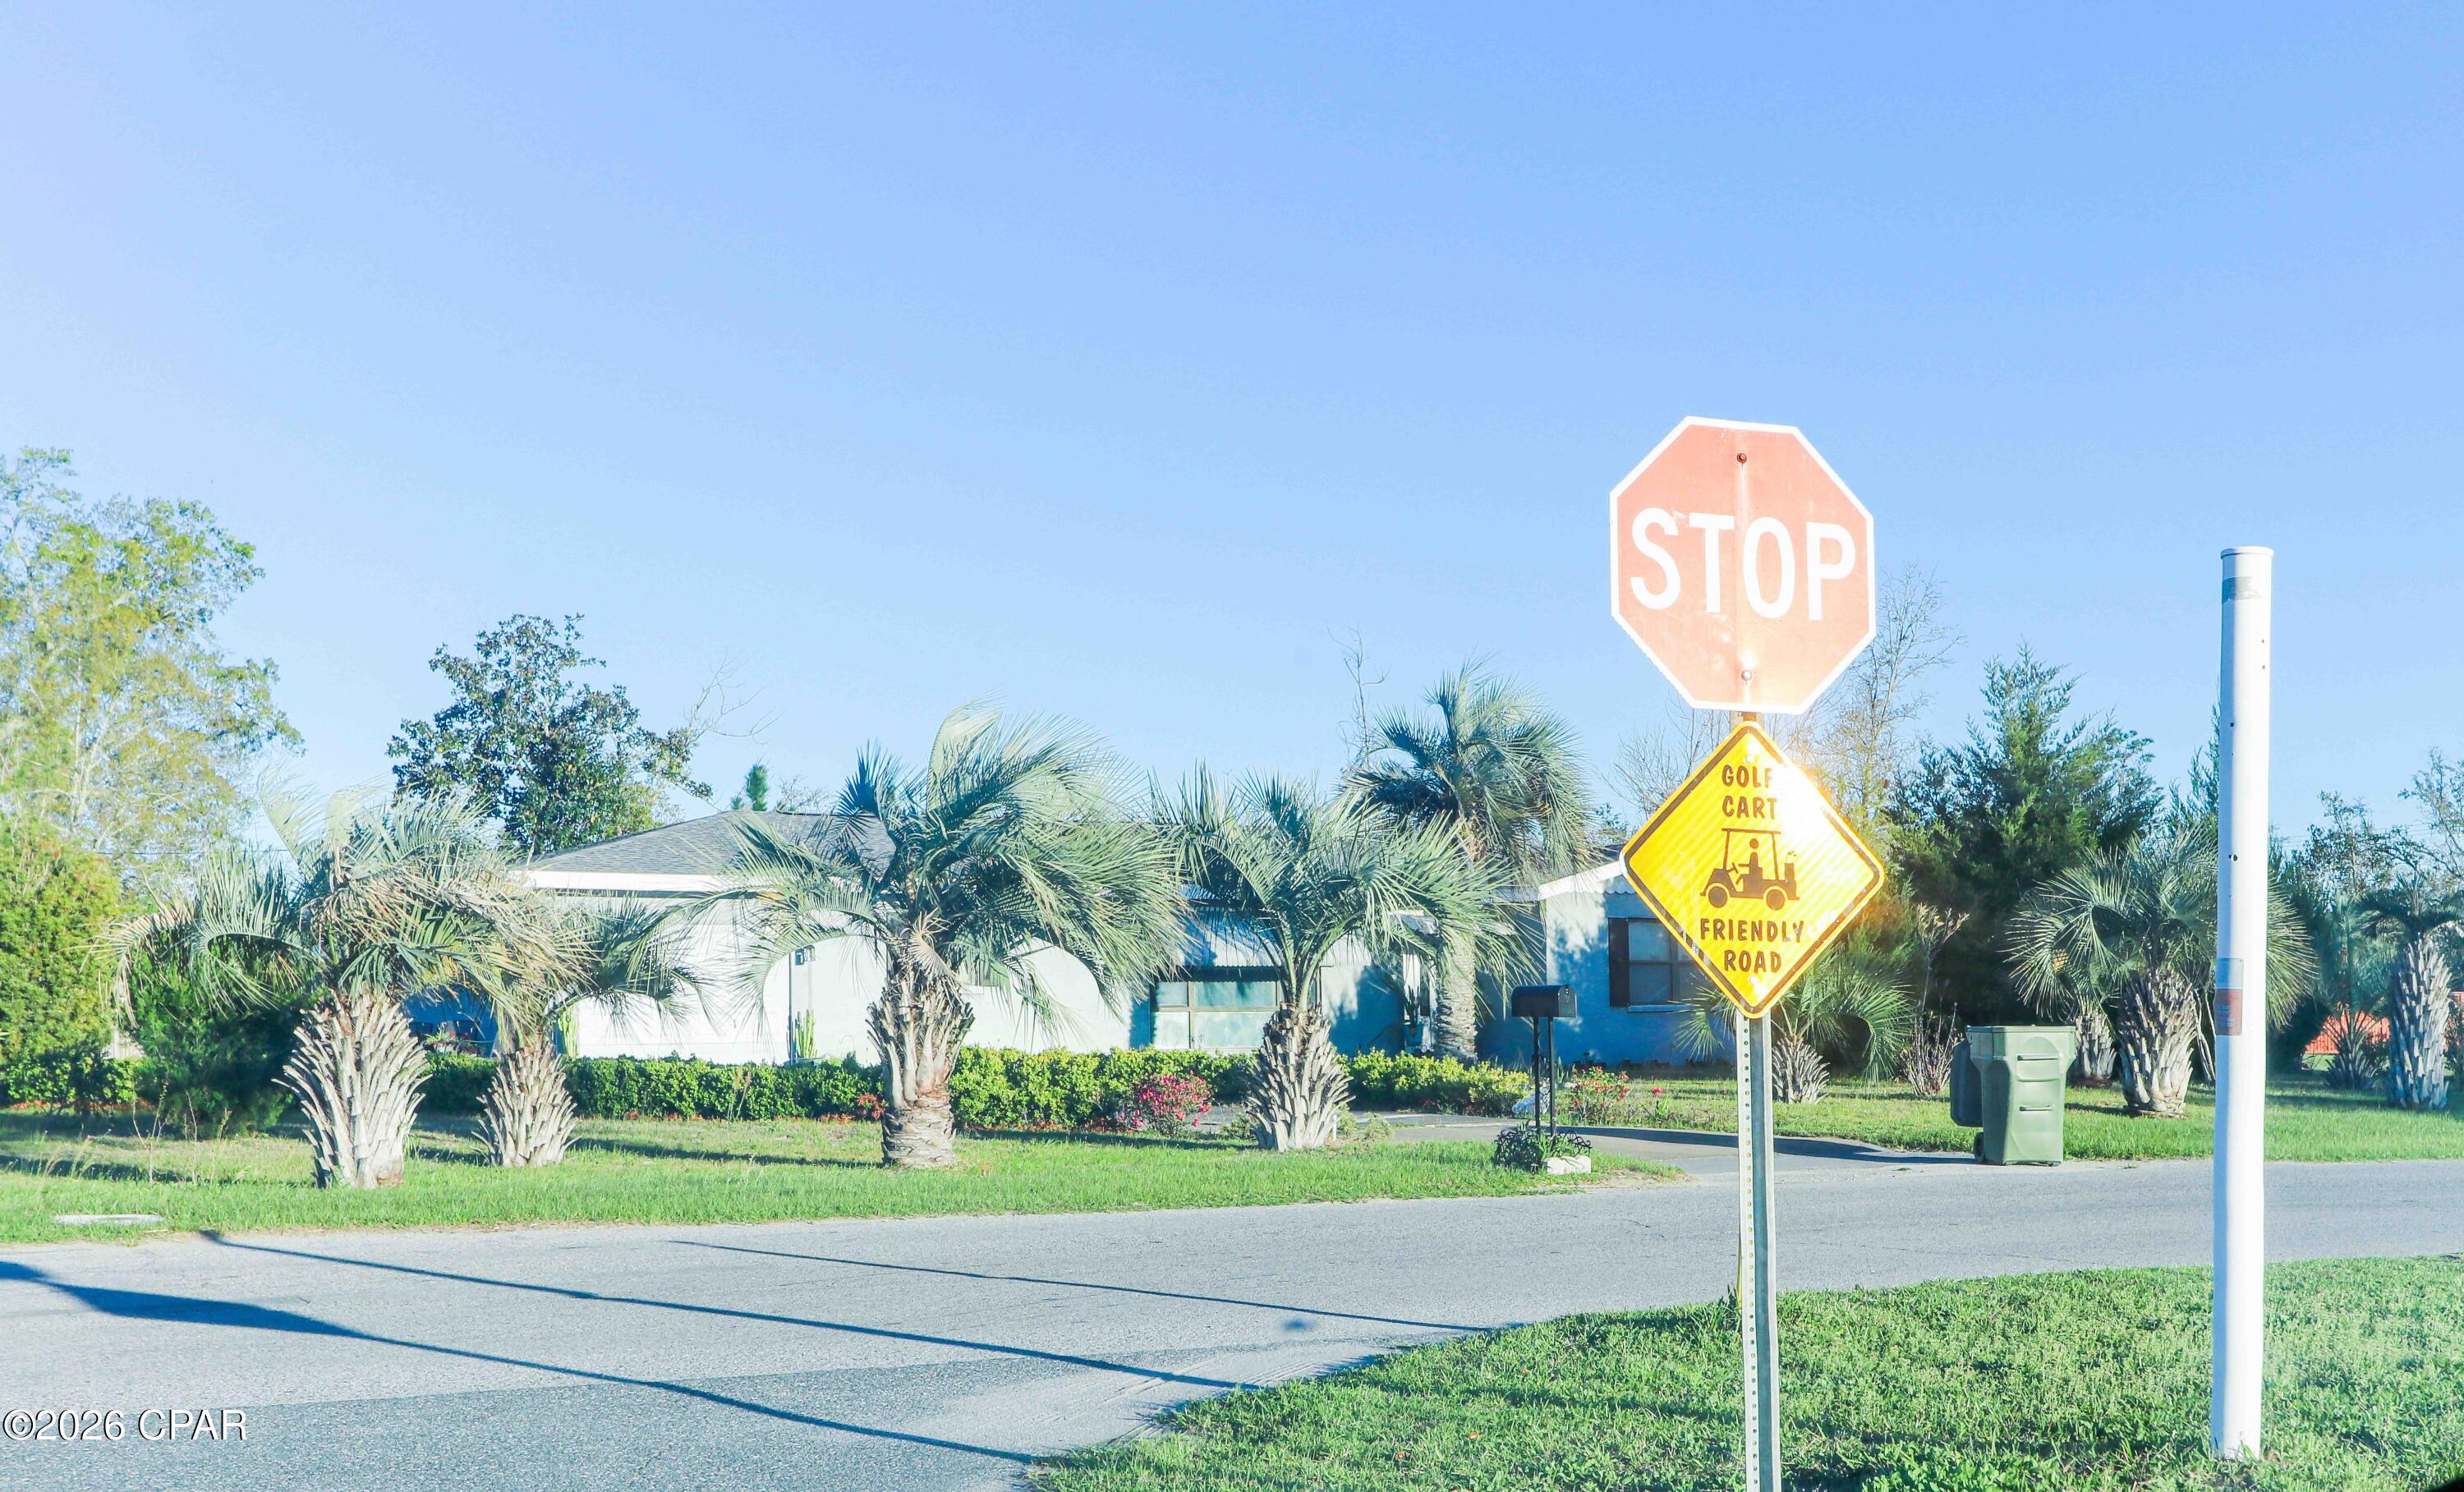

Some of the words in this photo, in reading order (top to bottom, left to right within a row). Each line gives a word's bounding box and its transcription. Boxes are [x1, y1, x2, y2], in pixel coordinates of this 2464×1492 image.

[1630, 507, 1856, 622] STOP
[1722, 764, 1773, 788] GOLF
[1722, 795, 1777, 820] CART
[1700, 918, 1804, 943] FRIENDLY
[1724, 949, 1782, 974] ROAD
